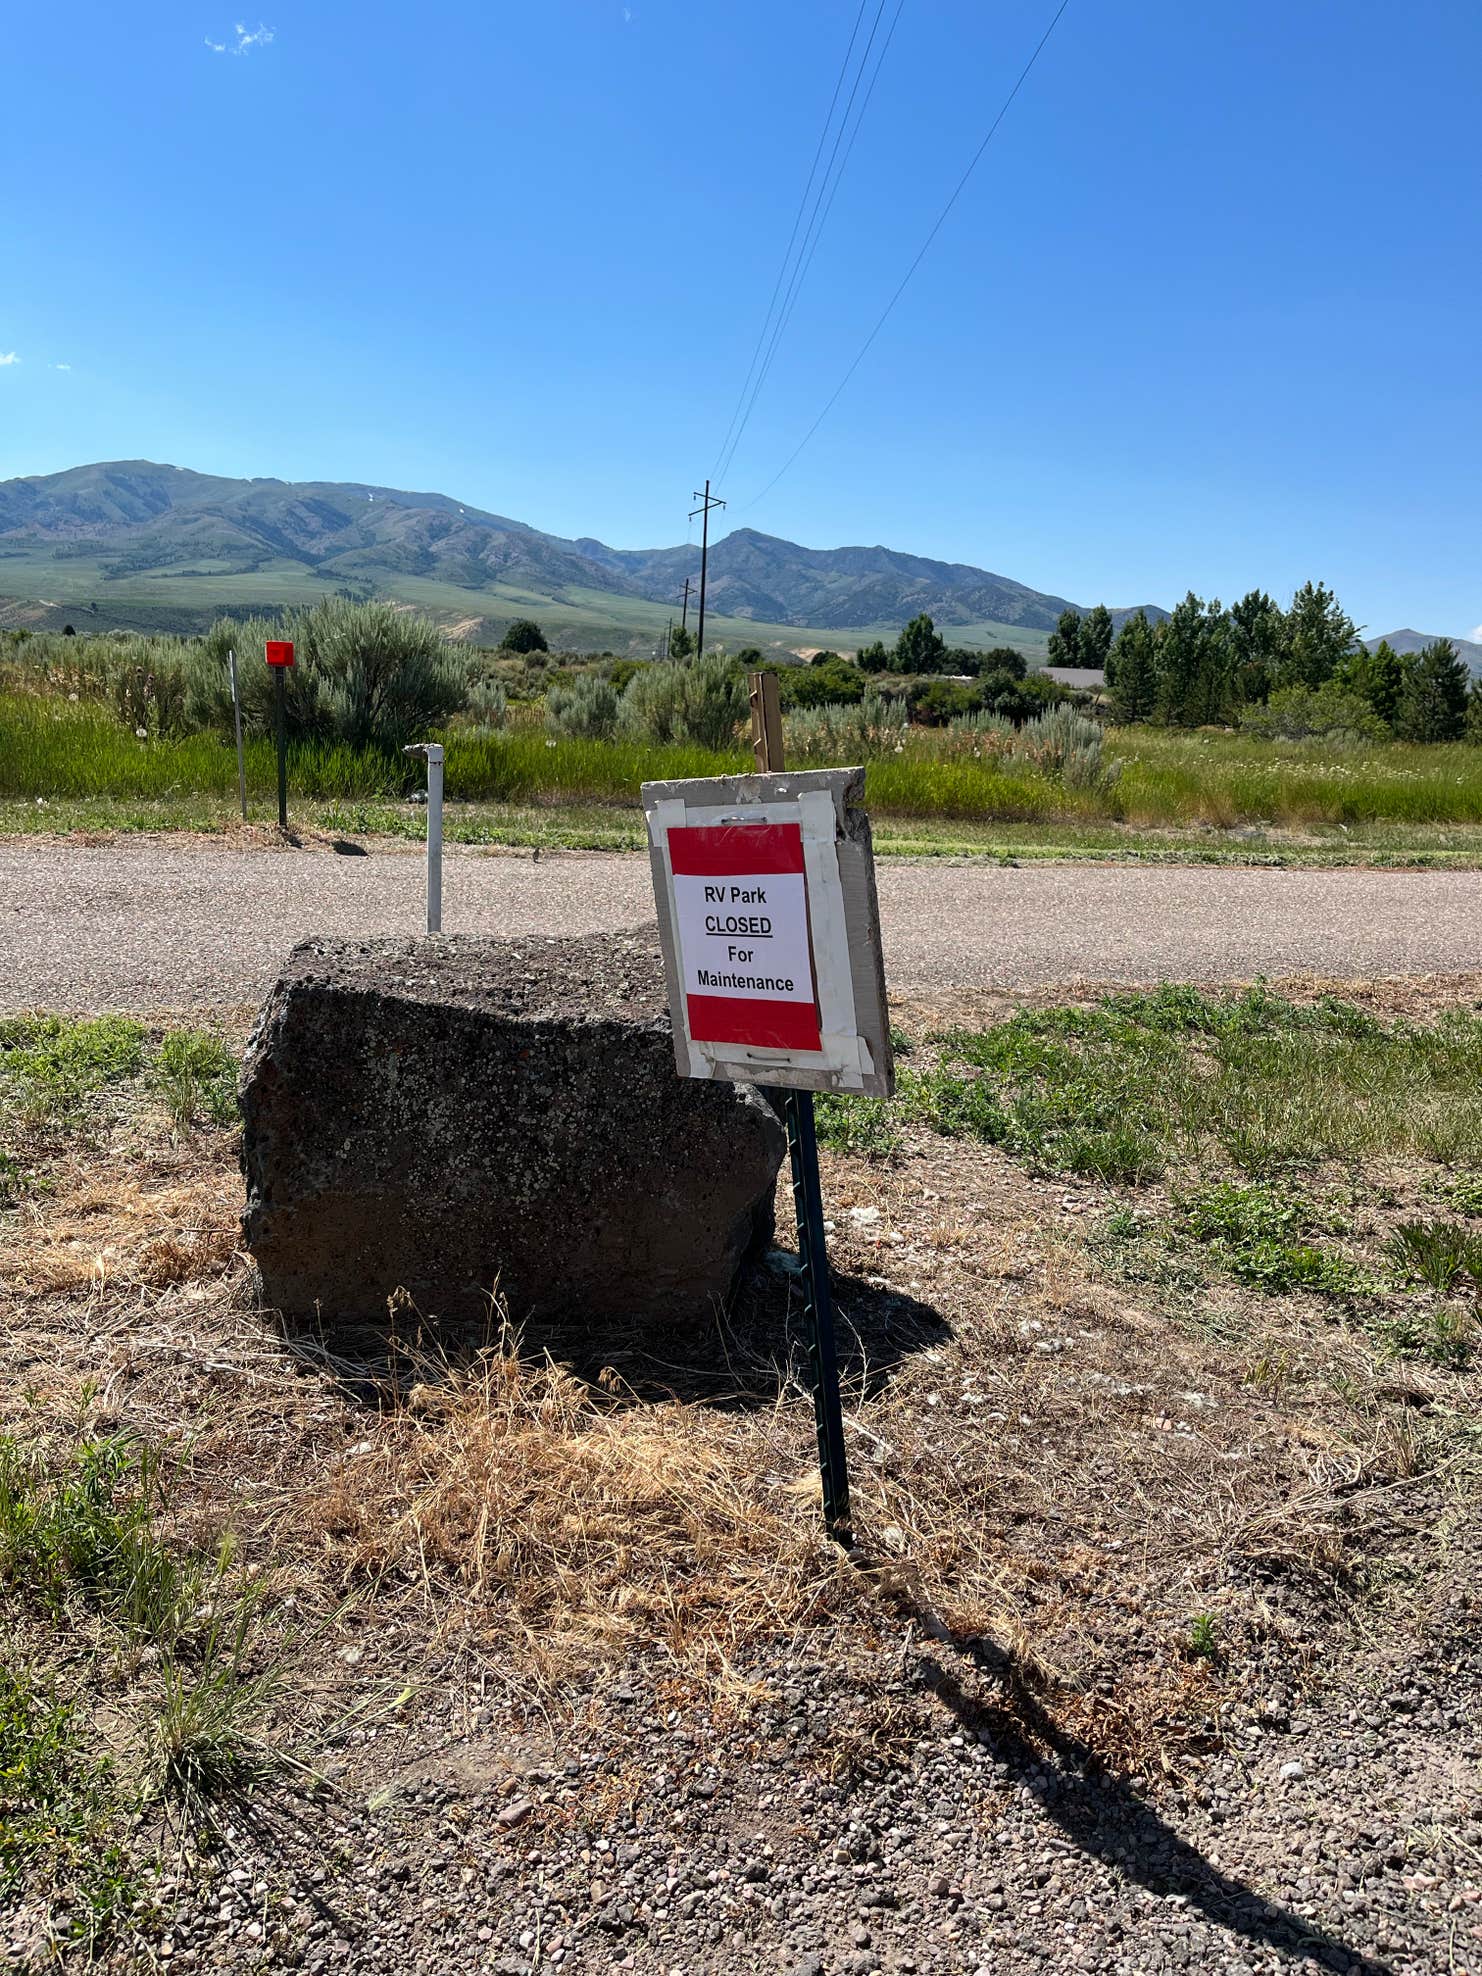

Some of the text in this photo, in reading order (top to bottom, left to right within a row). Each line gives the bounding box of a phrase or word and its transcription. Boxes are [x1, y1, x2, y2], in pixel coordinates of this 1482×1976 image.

[704, 886, 767, 904] RV Park
[705, 916, 772, 934] CLOSED
[728, 946, 754, 962] For
[697, 970, 795, 992] Maintenance
